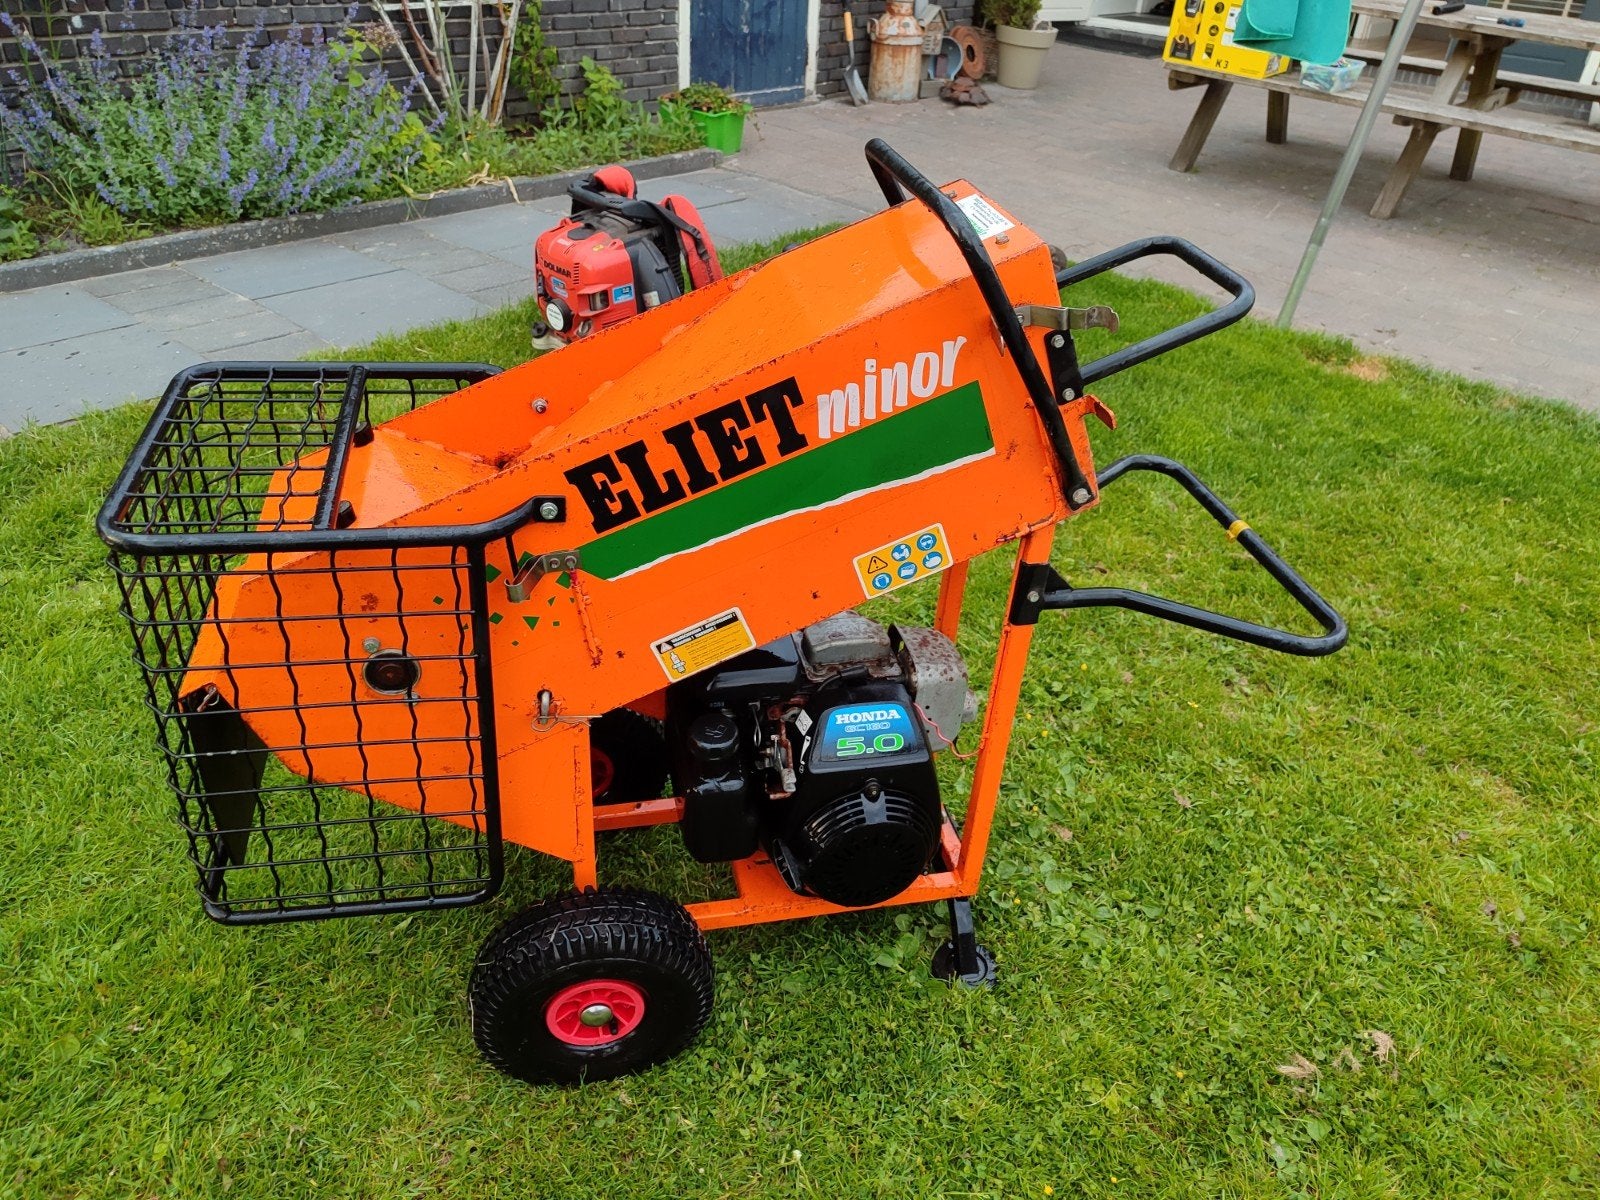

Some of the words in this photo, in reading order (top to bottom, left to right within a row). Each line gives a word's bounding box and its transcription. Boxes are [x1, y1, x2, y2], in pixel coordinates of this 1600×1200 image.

[543, 260, 572, 278] DOLMAR
[563, 376, 809, 535] ELIET
[816, 335, 967, 438] minor
[835, 709, 901, 724] HONDA
[844, 721, 891, 733] GC160
[836, 733, 904, 756] 5.0
